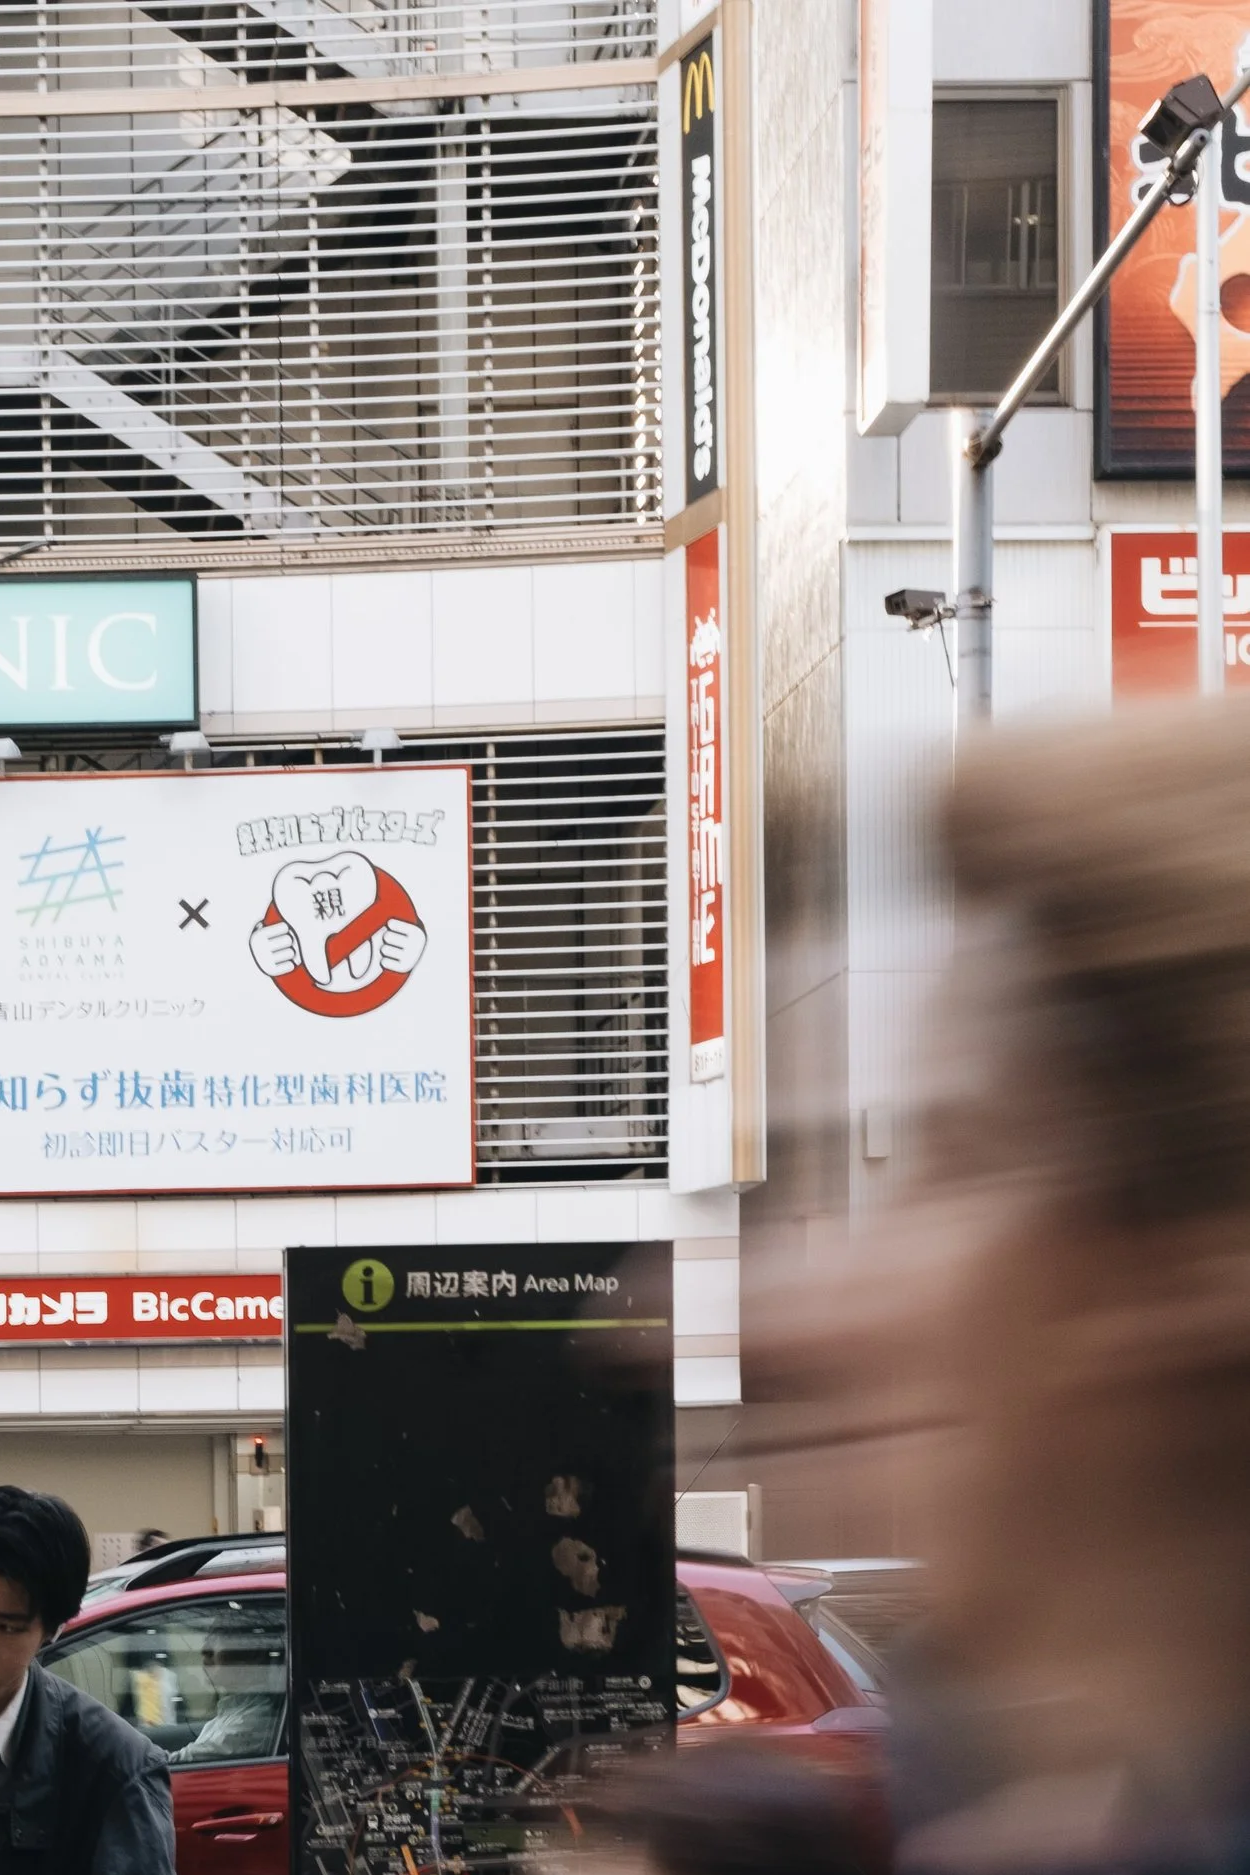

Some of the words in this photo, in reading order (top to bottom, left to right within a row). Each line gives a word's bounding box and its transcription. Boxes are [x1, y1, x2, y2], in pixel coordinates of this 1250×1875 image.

[691, 154, 713, 481] McDonald's
[312, 888, 345, 920] 親
[19, 934, 125, 949] SHIBUYA
[20, 953, 125, 968] AOYAMA
[523, 1275, 569, 1293] Area
[574, 1273, 619, 1297] Map
